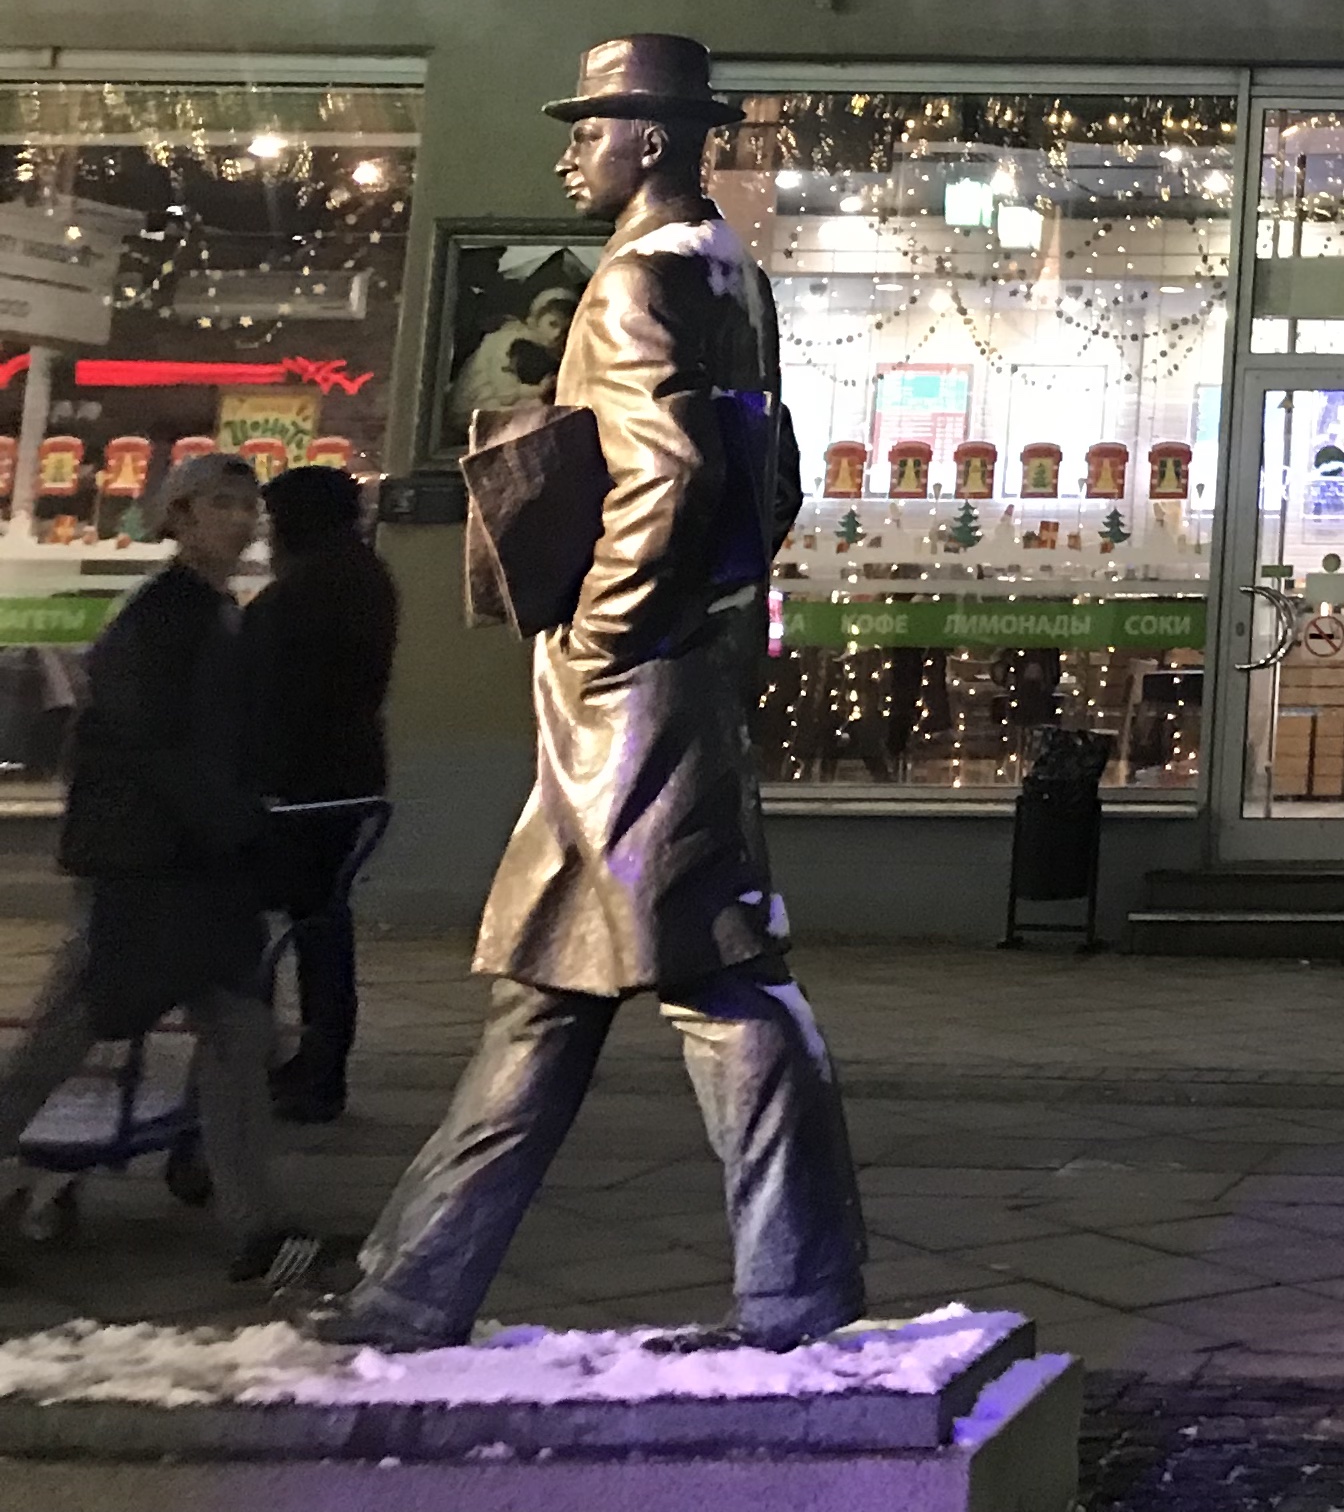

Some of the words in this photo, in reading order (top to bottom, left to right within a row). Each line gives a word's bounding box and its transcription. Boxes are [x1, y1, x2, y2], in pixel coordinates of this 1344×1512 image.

[841, 614, 909, 635] КОФЕ
[943, 613, 1092, 640] ЛИМОНАДЫ
[1123, 615, 1191, 636] СОКИ
